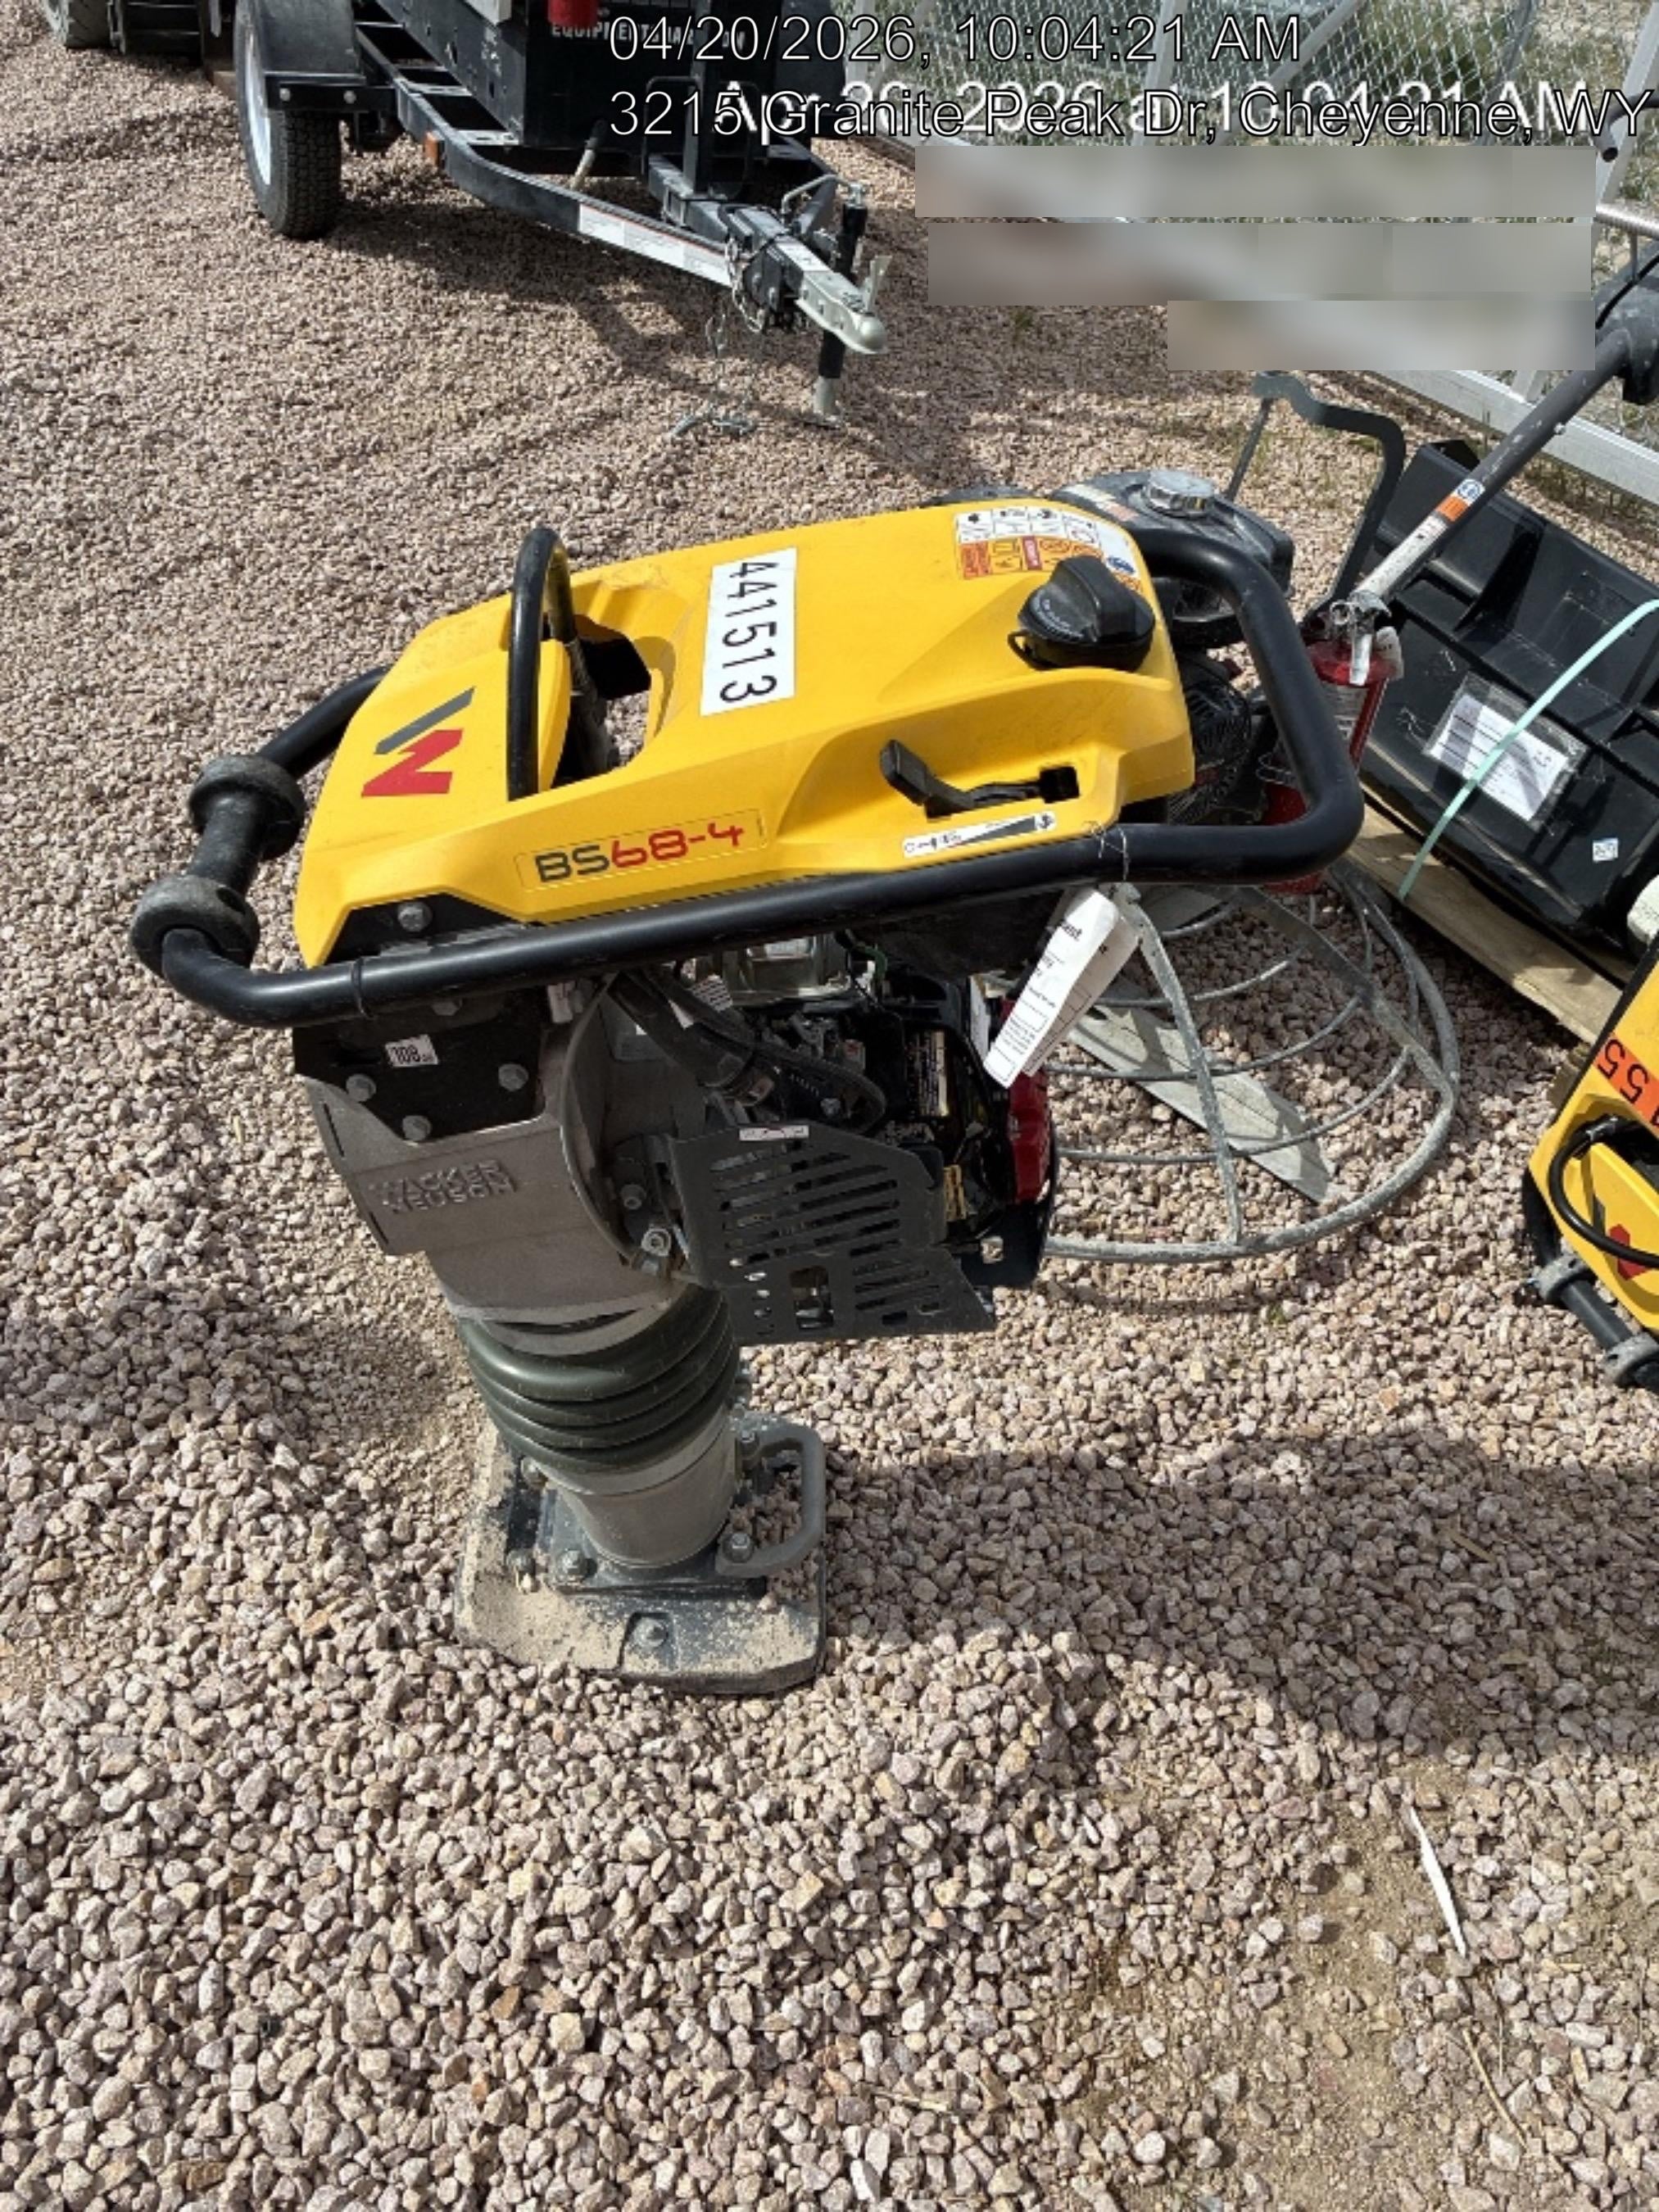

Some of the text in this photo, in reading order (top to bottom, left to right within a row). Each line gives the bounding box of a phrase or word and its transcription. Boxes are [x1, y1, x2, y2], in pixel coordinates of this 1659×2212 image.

[719, 562, 780, 703] 441513
[535, 822, 745, 882] BS68-4
[1597, 1038, 1659, 1128] 55
